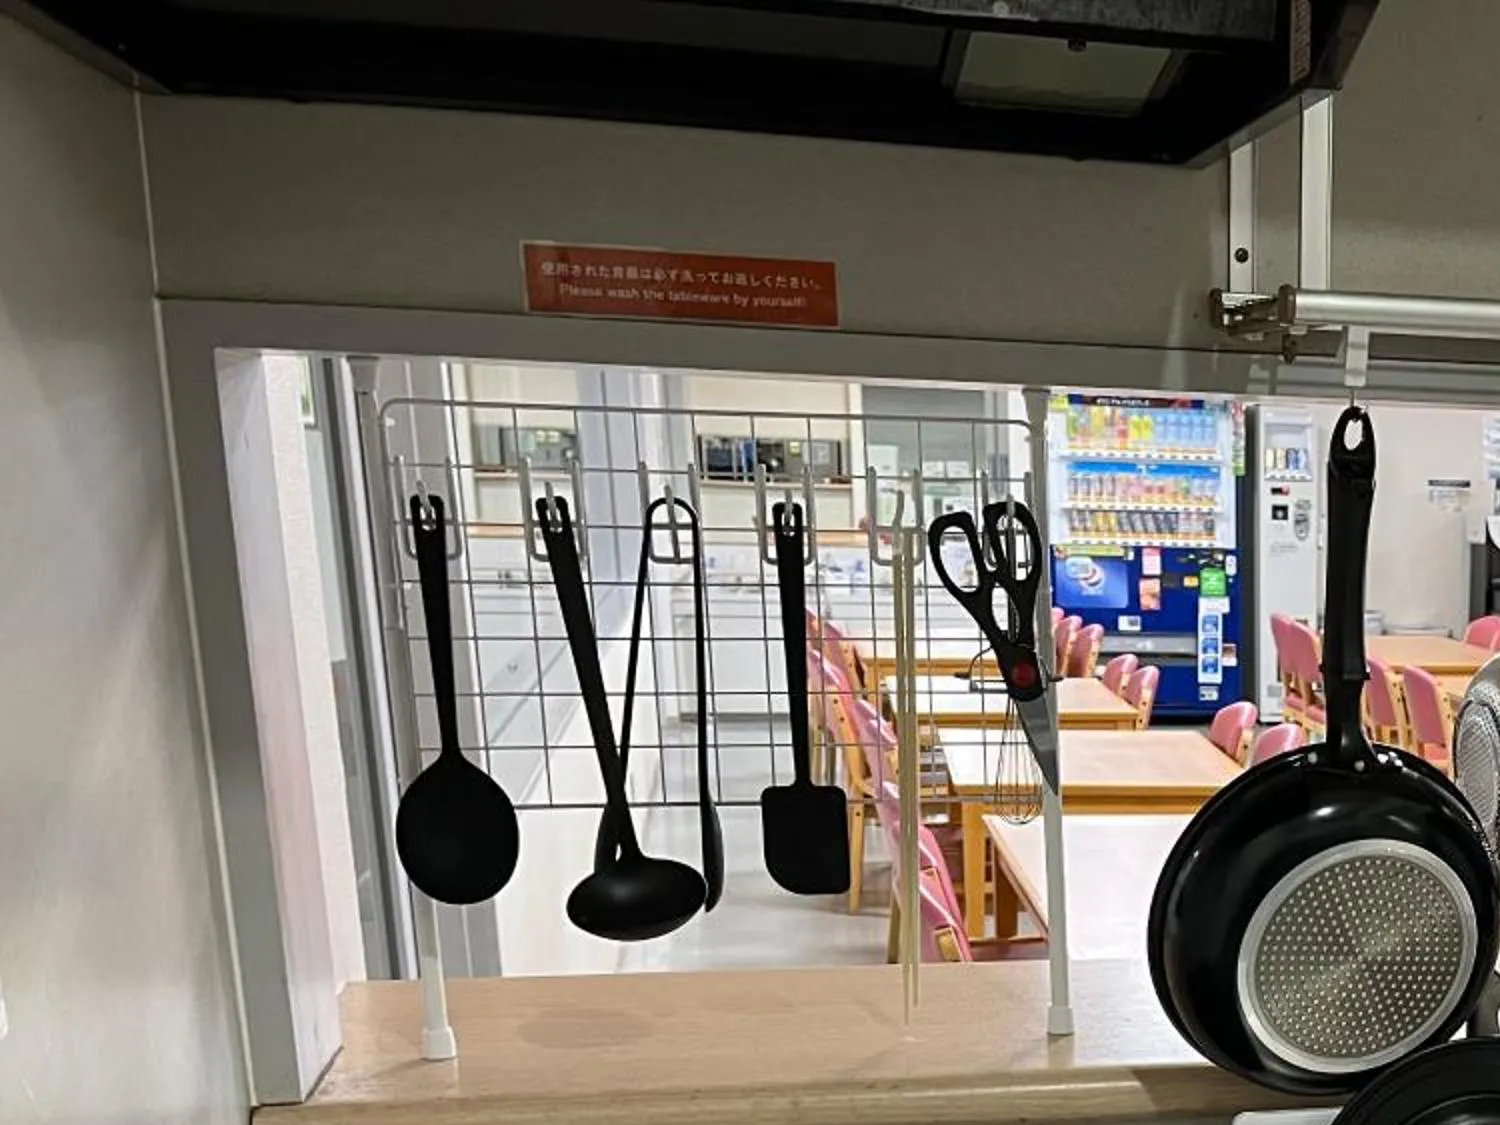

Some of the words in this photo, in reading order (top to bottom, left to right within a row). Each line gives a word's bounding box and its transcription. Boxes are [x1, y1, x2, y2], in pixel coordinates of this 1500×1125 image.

[559, 283, 603, 297] Please
[608, 287, 639, 300] wash
[642, 288, 665, 301] the
[668, 290, 729, 304] tableware
[733, 293, 749, 307] by
